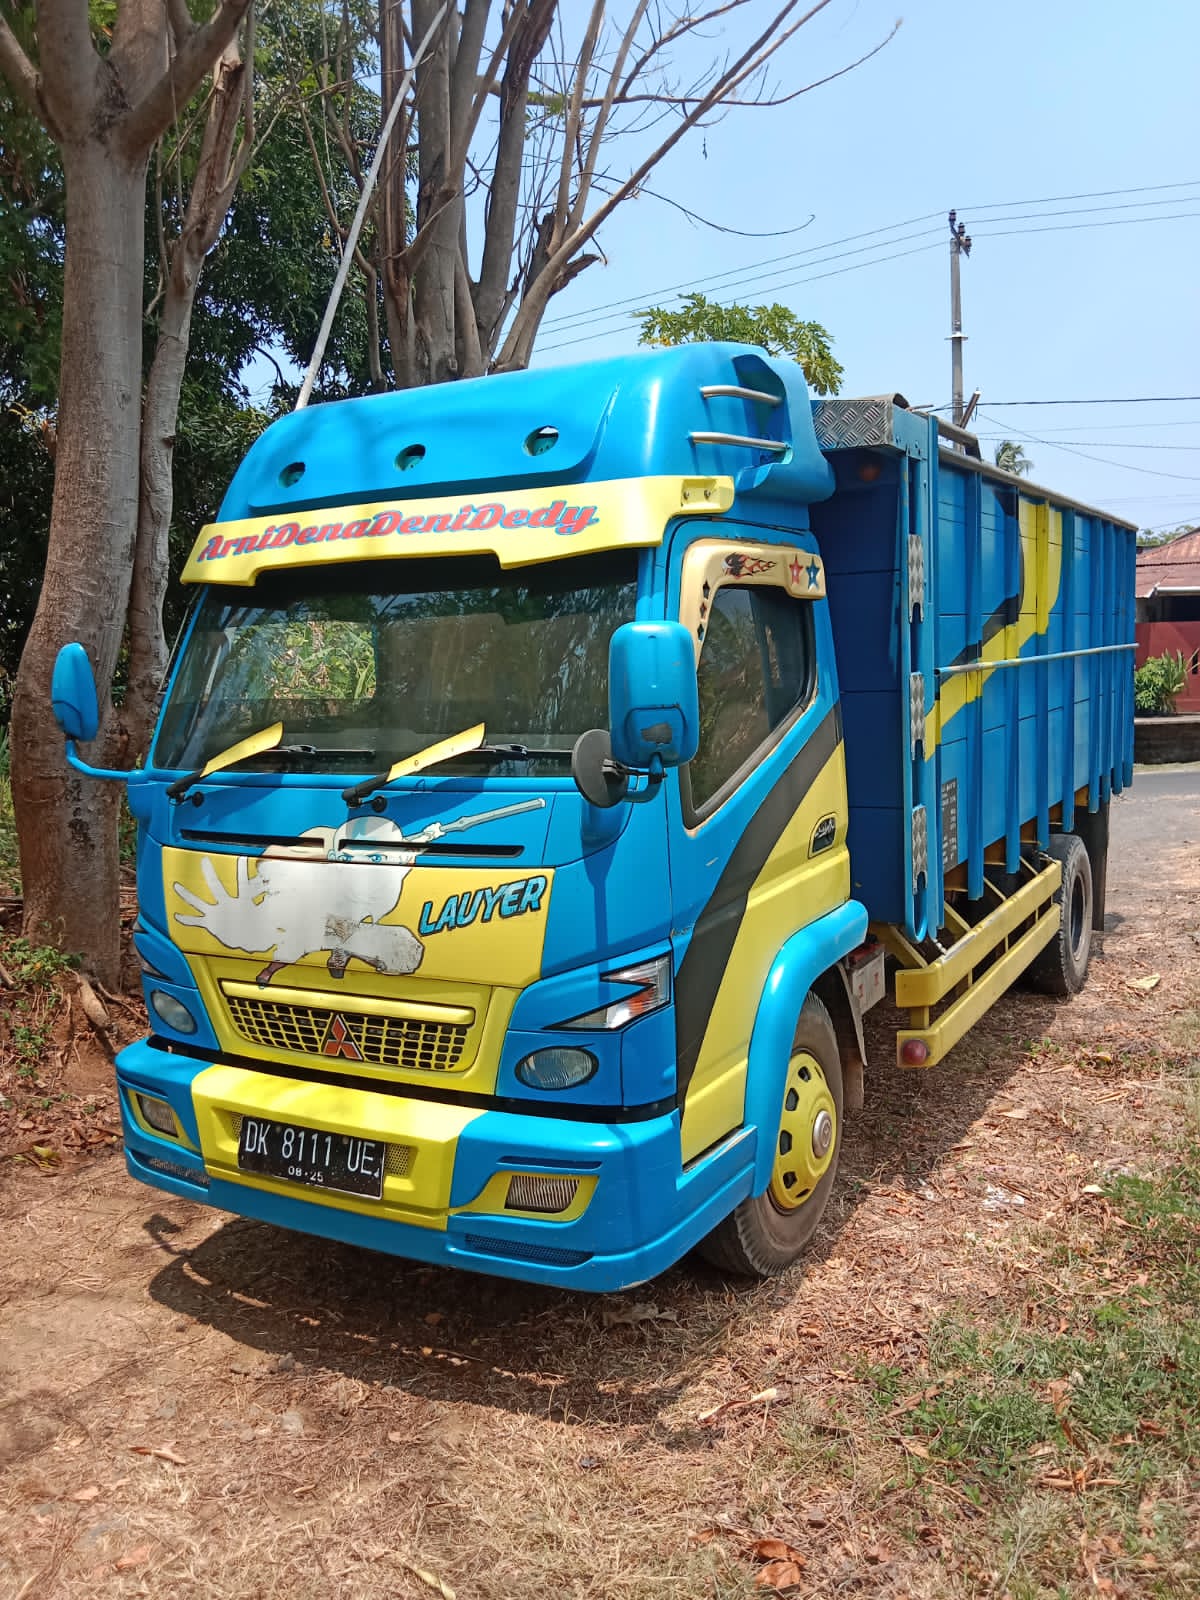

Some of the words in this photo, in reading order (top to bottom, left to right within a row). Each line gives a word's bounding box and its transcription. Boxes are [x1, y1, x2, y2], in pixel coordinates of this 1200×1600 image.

[418, 875, 547, 937] LAUYER
[245, 1121, 271, 1156] DK
[281, 1128, 332, 1167] 8111
[347, 1138, 376, 1175] UE
